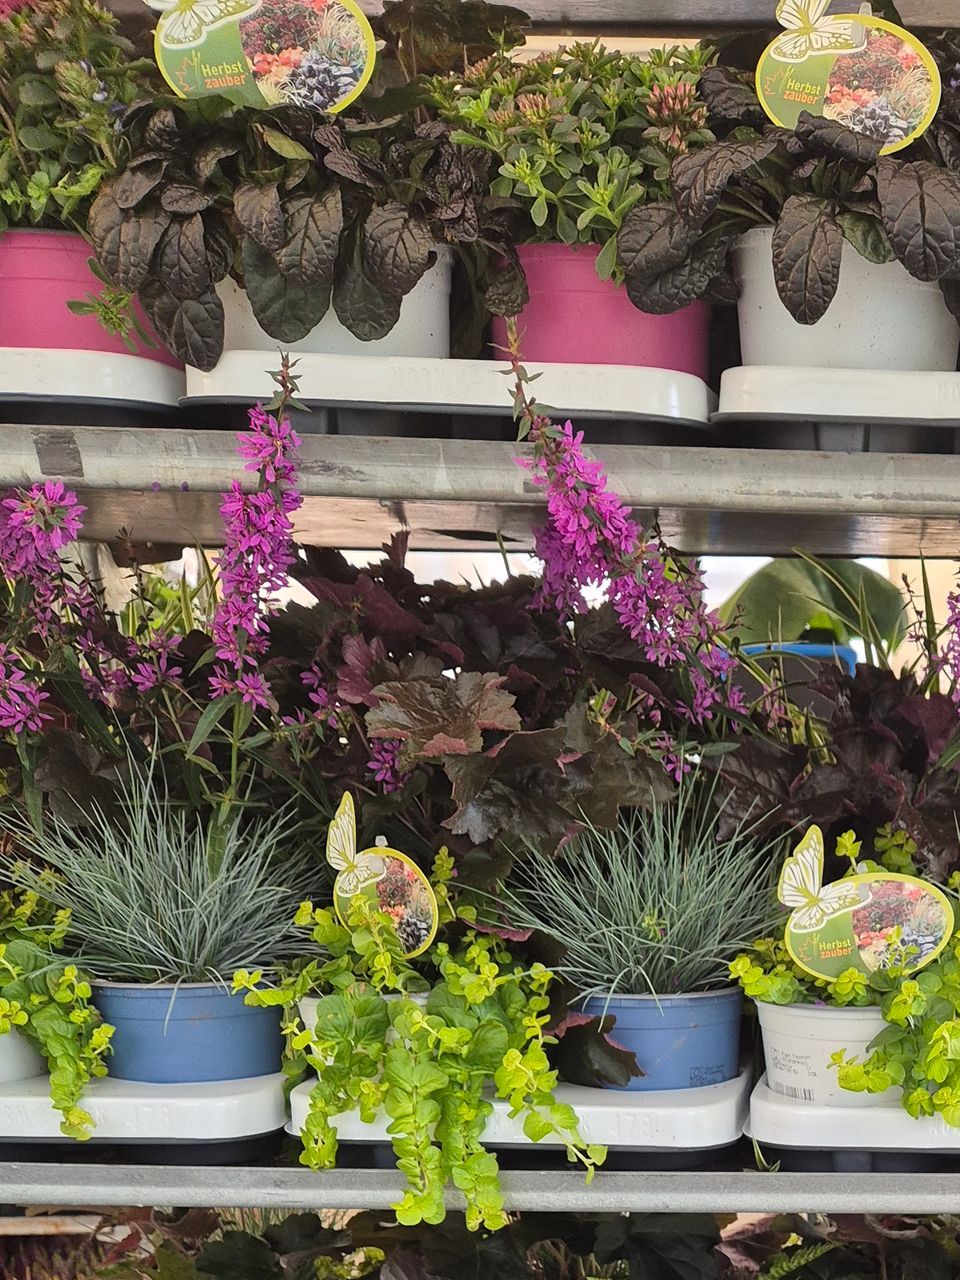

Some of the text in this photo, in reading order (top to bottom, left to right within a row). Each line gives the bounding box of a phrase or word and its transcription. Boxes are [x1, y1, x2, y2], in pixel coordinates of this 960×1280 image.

[201, 61, 244, 77] Herbst
[205, 74, 246, 89] zauber
[786, 78, 822, 96] Herbst
[783, 90, 819, 105] zauber
[819, 939, 852, 951] Herbst
[820, 948, 853, 959] zauber
